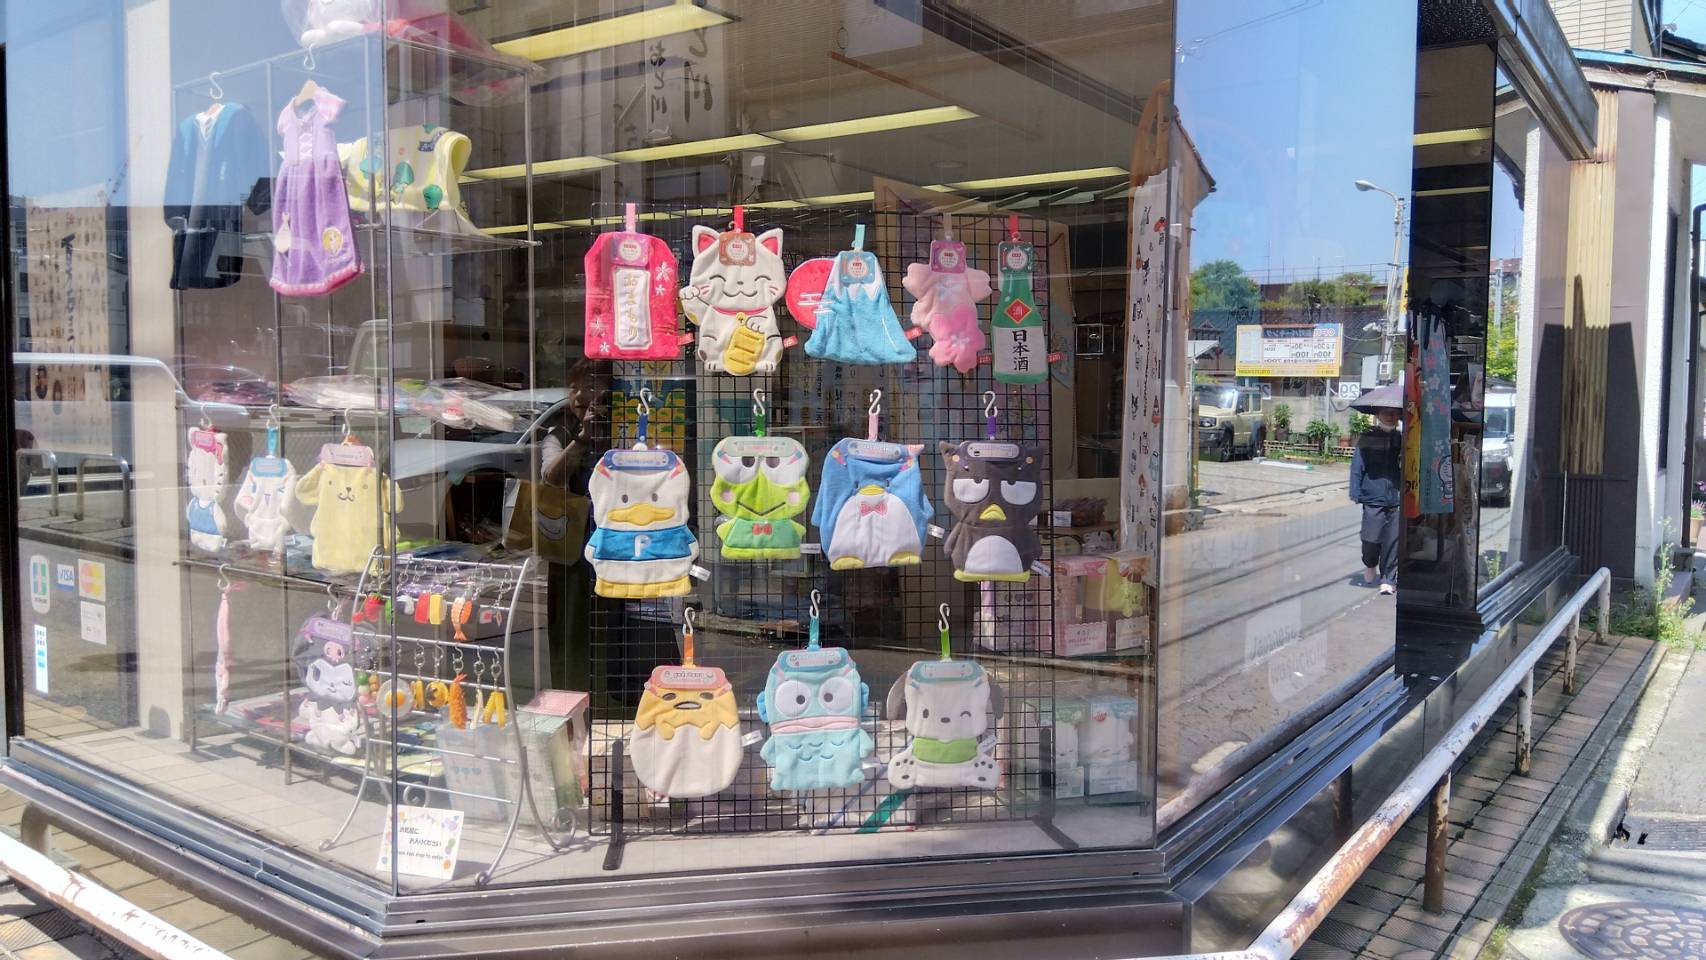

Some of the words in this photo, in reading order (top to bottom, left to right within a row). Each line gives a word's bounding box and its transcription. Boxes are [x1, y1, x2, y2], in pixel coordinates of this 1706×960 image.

[624, 273, 639, 341] おまもり
[1011, 329, 1029, 372] 日本酒
[634, 534, 650, 557] P
[60, 569, 74, 580] VISA
